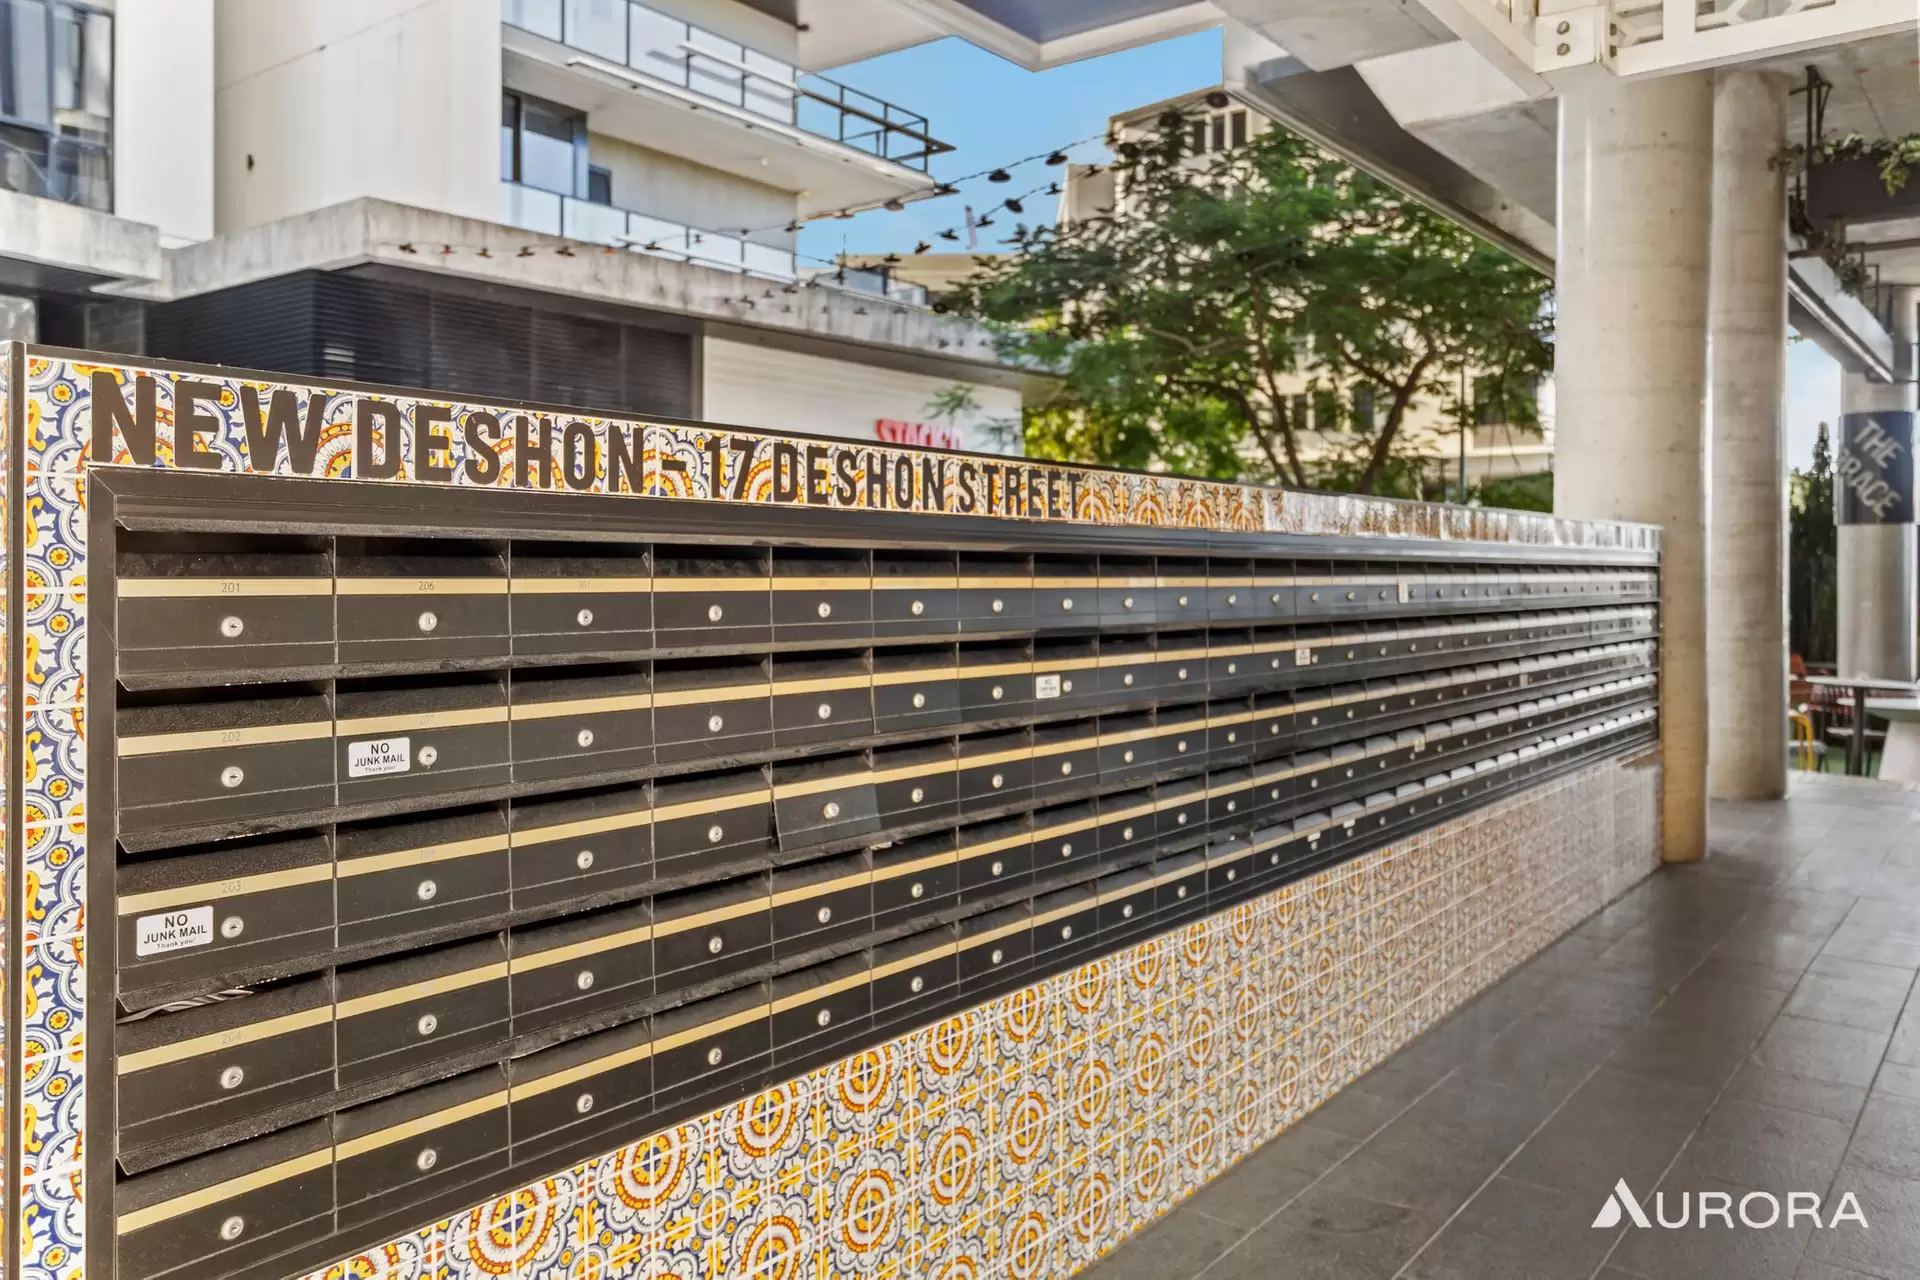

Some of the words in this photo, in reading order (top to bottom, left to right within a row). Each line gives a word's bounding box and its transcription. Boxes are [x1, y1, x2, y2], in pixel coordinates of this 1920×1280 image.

[89, 371, 327, 474] NEW
[356, 399, 646, 494] DESHON
[705, 435, 755, 499] 17
[772, 441, 946, 512] DESHON
[956, 461, 1084, 519] STREET
[1853, 419, 1905, 469] THE
[221, 583, 240, 593] 201
[418, 581, 434, 591] 206
[221, 732, 241, 743] 202
[371, 743, 389, 755] NO
[354, 756, 380, 767] JUNK
[382, 754, 405, 763] MAIL
[222, 881, 242, 893] 203
[165, 914, 188, 928] NO
[144, 930, 176, 944] JUNK
[179, 925, 207, 937] MAIL
[157, 940, 178, 949] Thank
